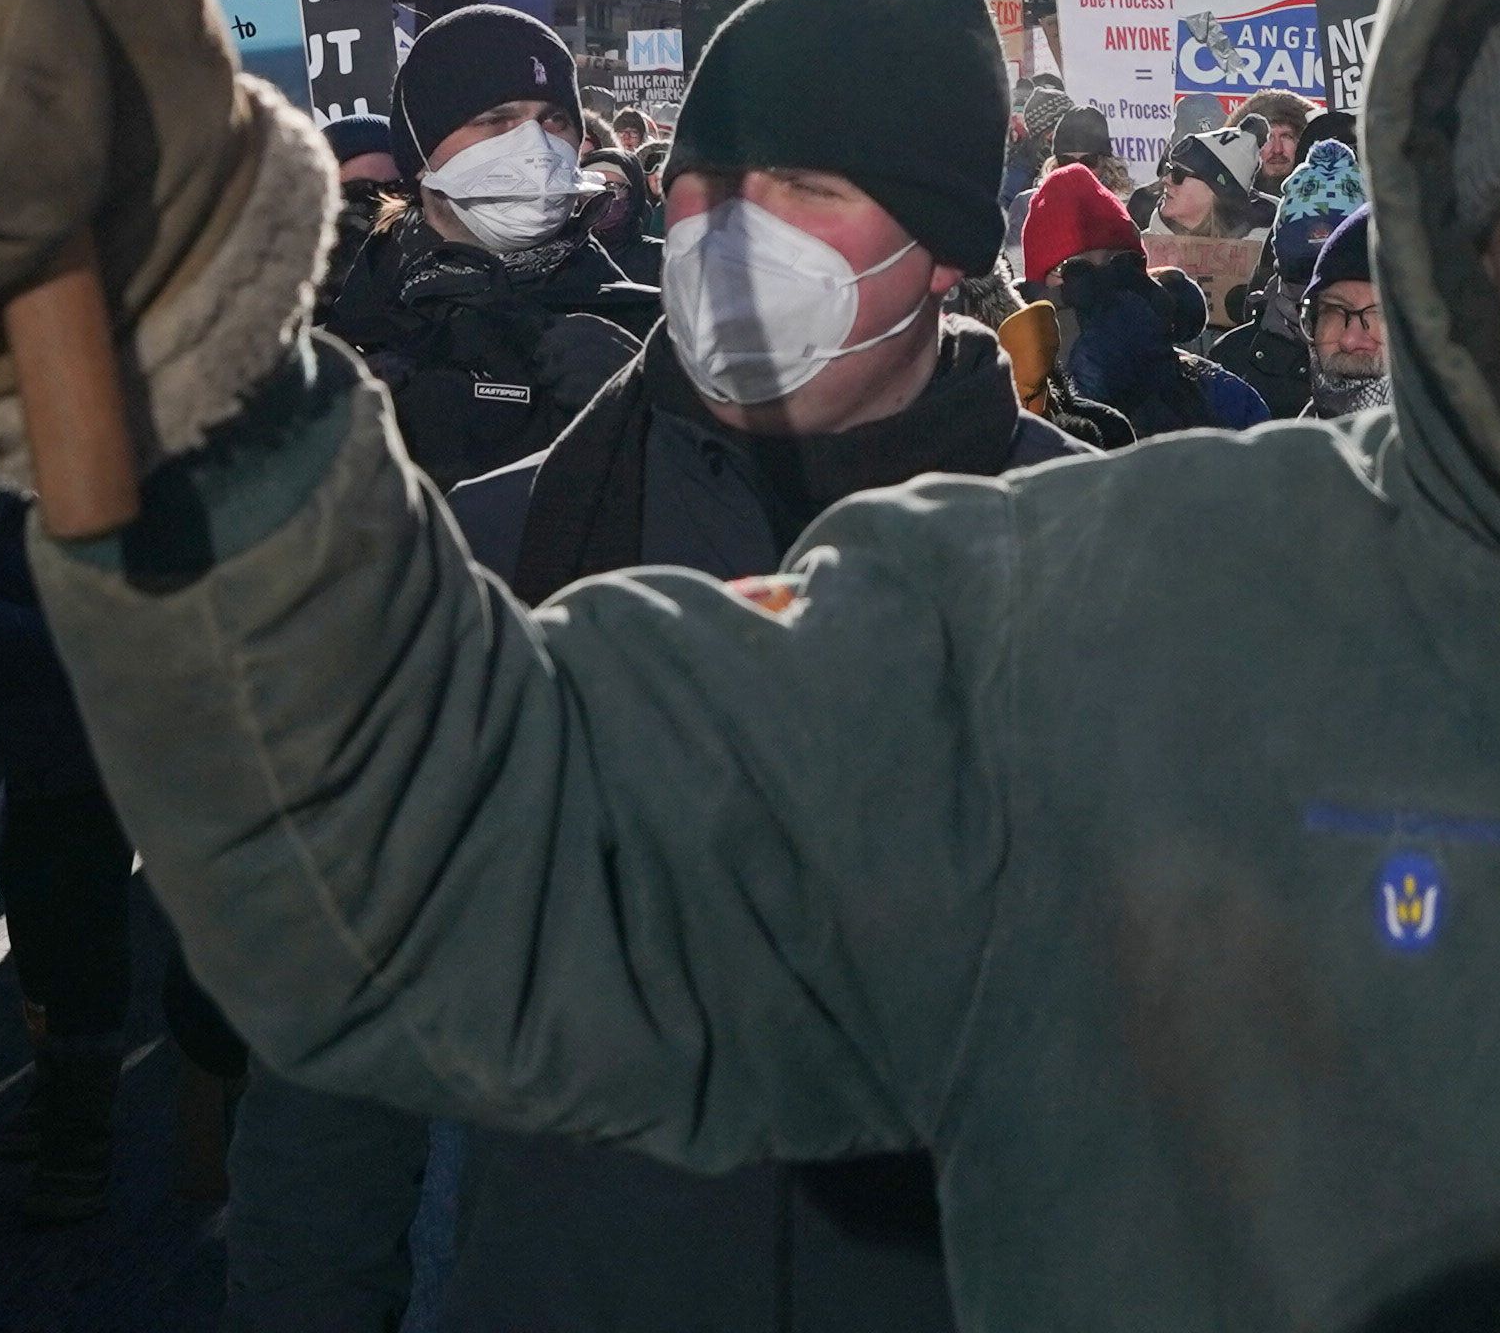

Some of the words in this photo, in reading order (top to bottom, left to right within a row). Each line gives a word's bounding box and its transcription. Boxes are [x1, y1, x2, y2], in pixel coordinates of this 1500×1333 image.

[231, 15, 257, 40] to
[1105, 26, 1172, 51] ANYONE
[1237, 25, 1316, 50] ANGI
[633, 32, 681, 65] MN
[646, 89, 682, 102] AMERIC
[1120, 99, 1172, 120] Process
